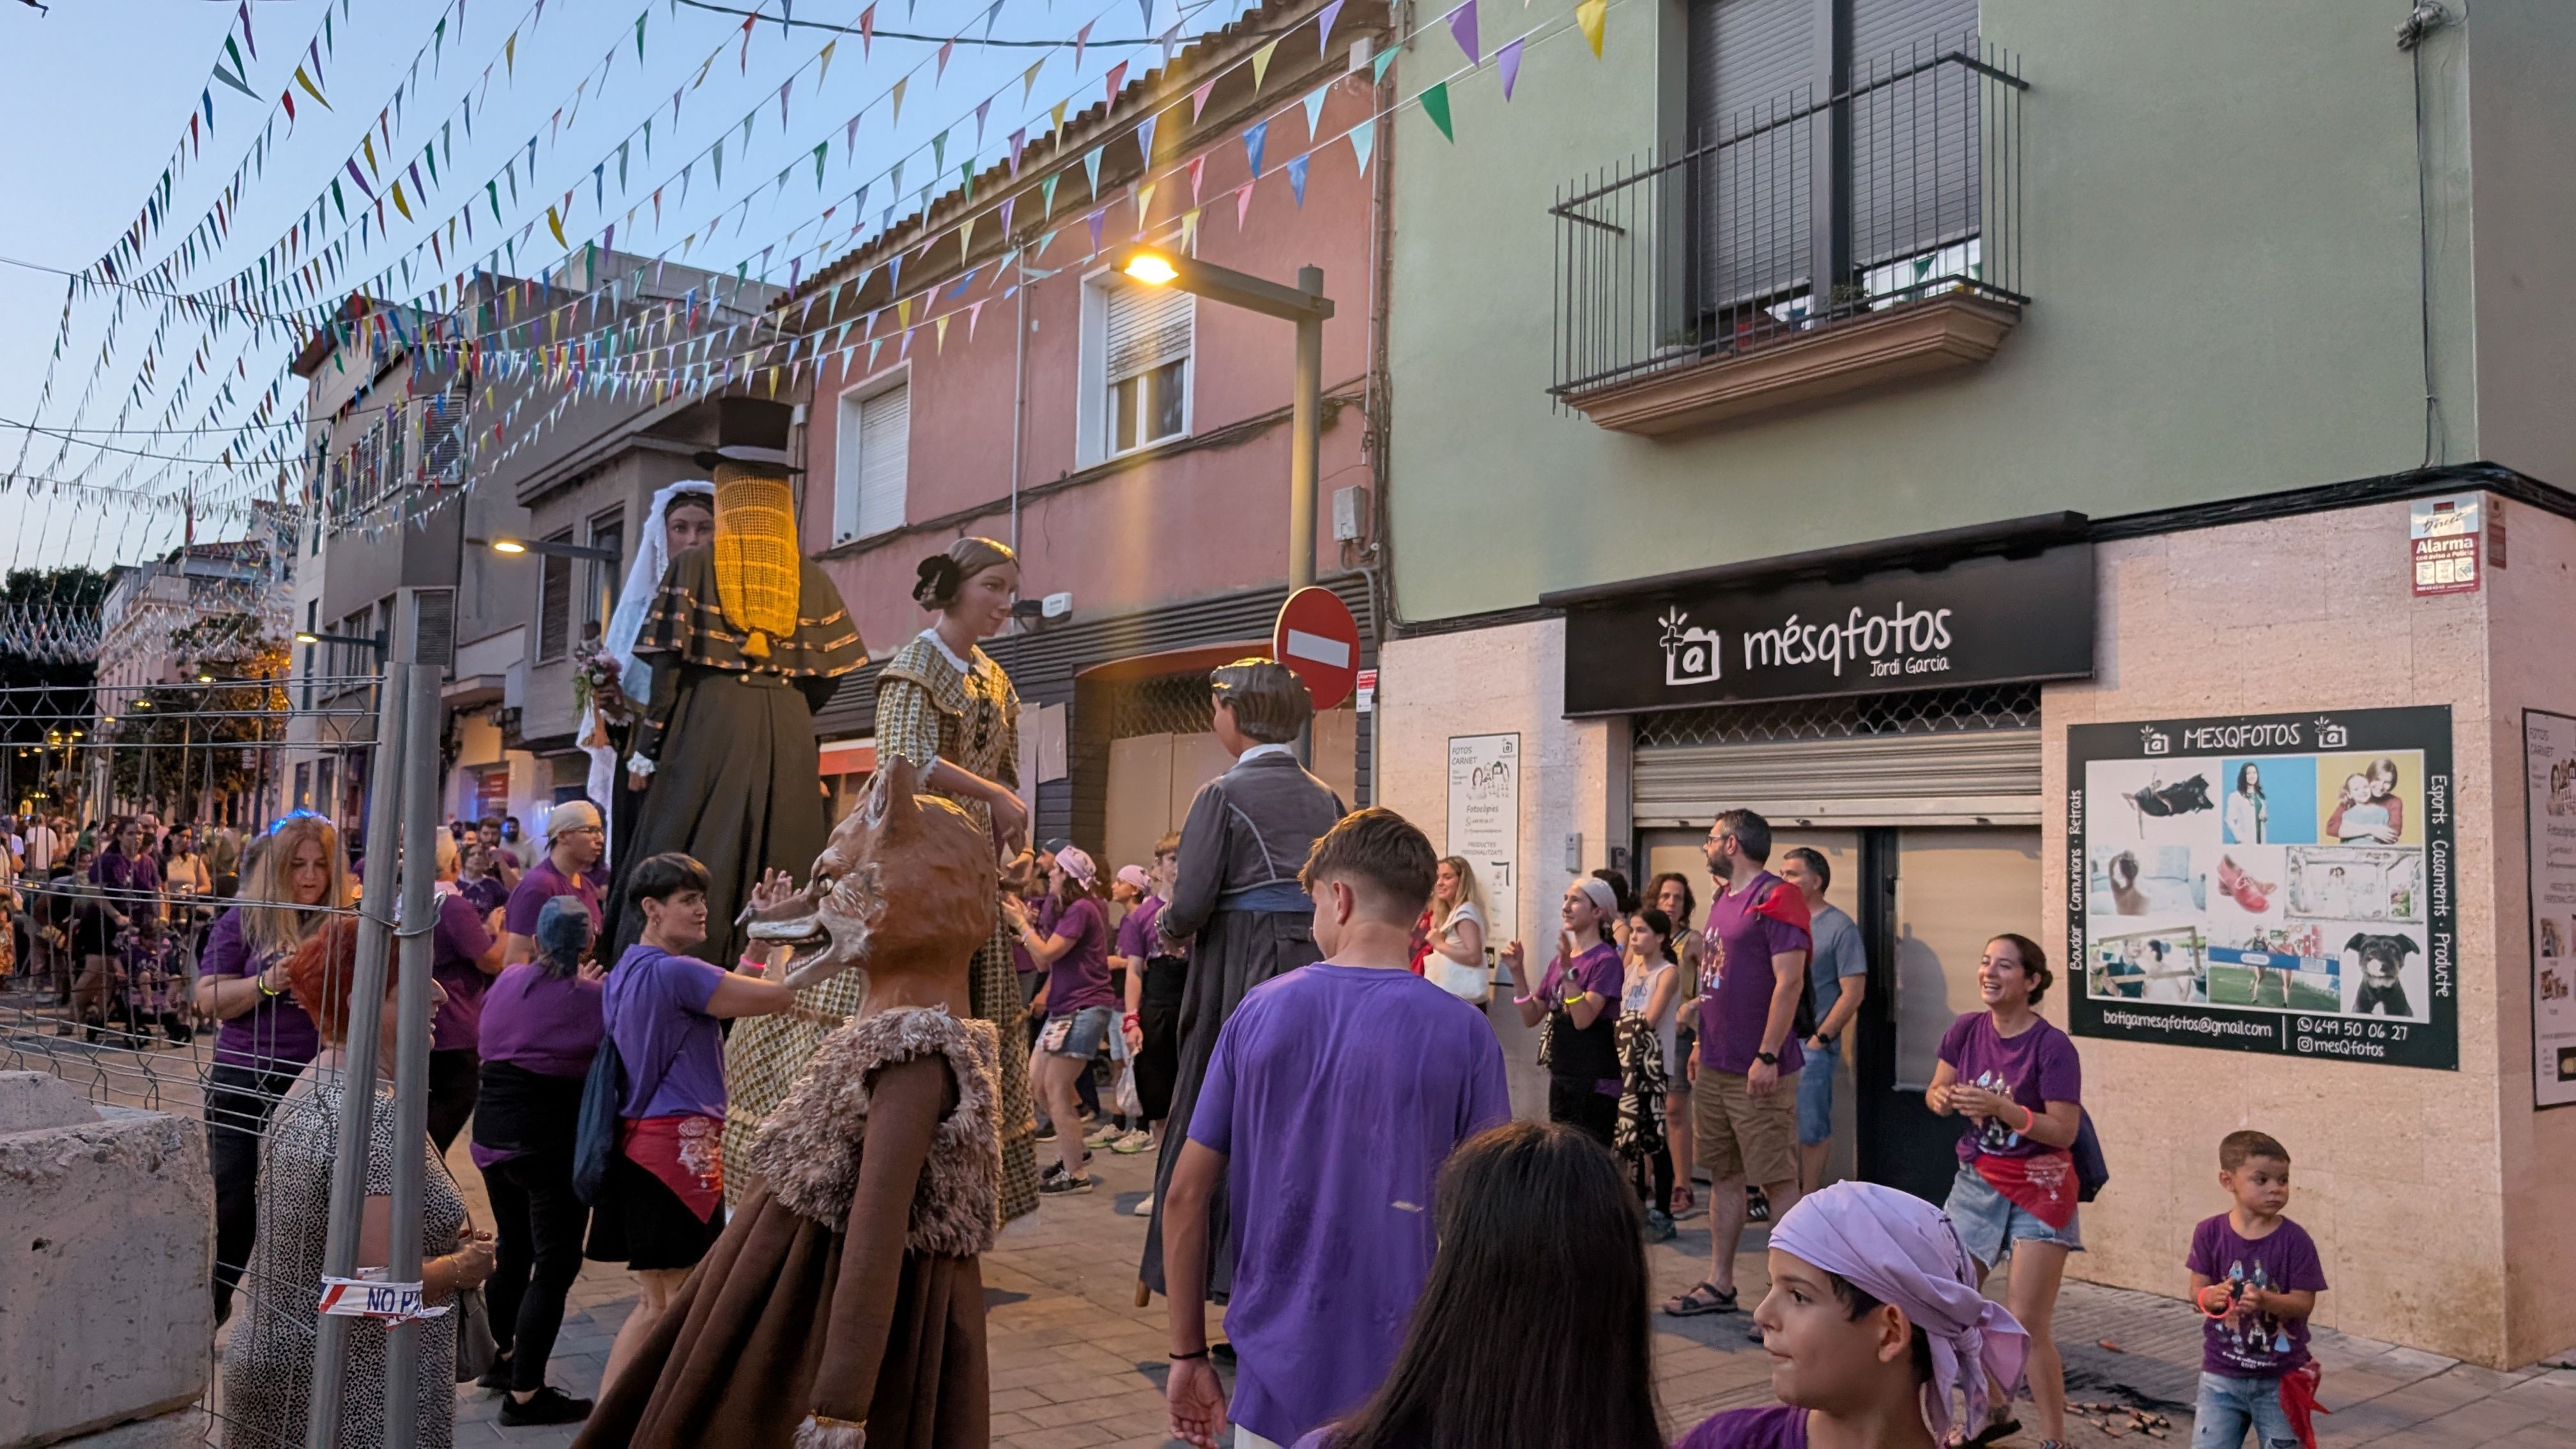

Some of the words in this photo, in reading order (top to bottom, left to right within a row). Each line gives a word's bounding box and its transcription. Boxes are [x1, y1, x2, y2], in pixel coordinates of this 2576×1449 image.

[2423, 511, 2464, 533] Direct
[2416, 537, 2474, 554] Alarma
[1744, 600, 1952, 677] mésqfotos
[1869, 658, 1901, 677] Jordi
[1905, 654, 1951, 674] Garcia
[2184, 723, 2301, 749] MESQFOTOS
[1452, 746, 1472, 755] FOTOS
[1452, 757, 1477, 765] CARNET
[1466, 804, 1499, 815] Fotocòpies
[2069, 789, 2082, 835] Retrats
[2426, 775, 2448, 824] Esports
[2069, 848, 2082, 911] Comunions
[2432, 839, 2450, 917] Casaments
[2069, 924, 2083, 970] Boudoir
[2434, 932, 2452, 998] Producte
[2103, 1009, 2273, 1037] botigamesqfotos@gmail.com
[2314, 1019, 2339, 1035] 649
[2343, 1022, 2362, 1036] 50
[2368, 1023, 2386, 1038] 06
[2391, 1025, 2408, 1041] 27
[2315, 1039, 2385, 1057] mesQfotos
[367, 1287, 395, 1312] NO
